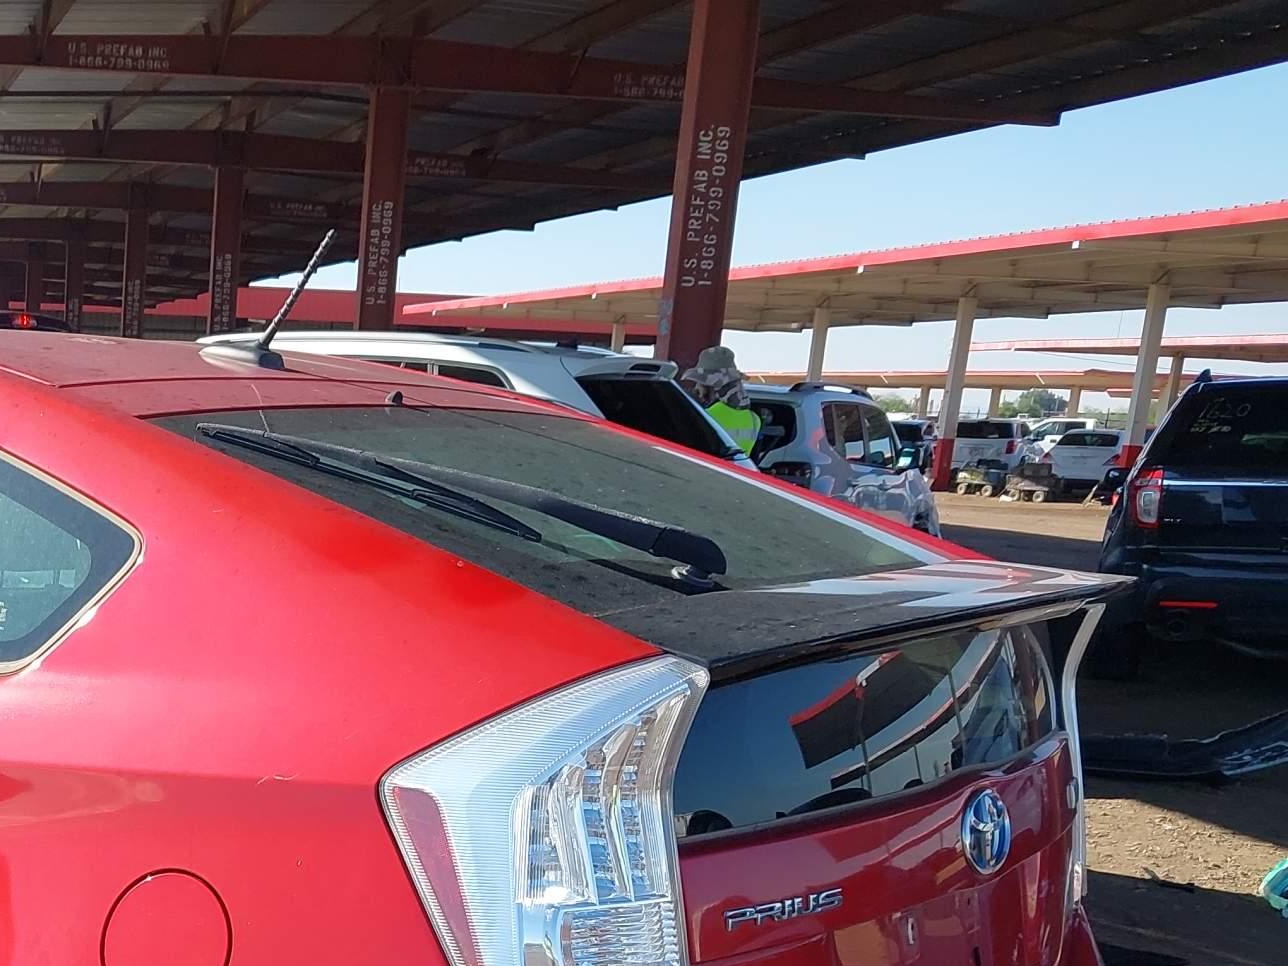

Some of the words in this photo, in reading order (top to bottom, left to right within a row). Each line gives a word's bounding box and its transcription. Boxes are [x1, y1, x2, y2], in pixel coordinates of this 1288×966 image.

[687, 169, 709, 242] PREFAB
[698, 126, 731, 286] 1-866-799-0969
[367, 229, 381, 275] PREFAB
[376, 201, 394, 304] 1-866-799-0969
[681, 252, 698, 287] U.S.
[724, 887, 843, 932] PRIUS
